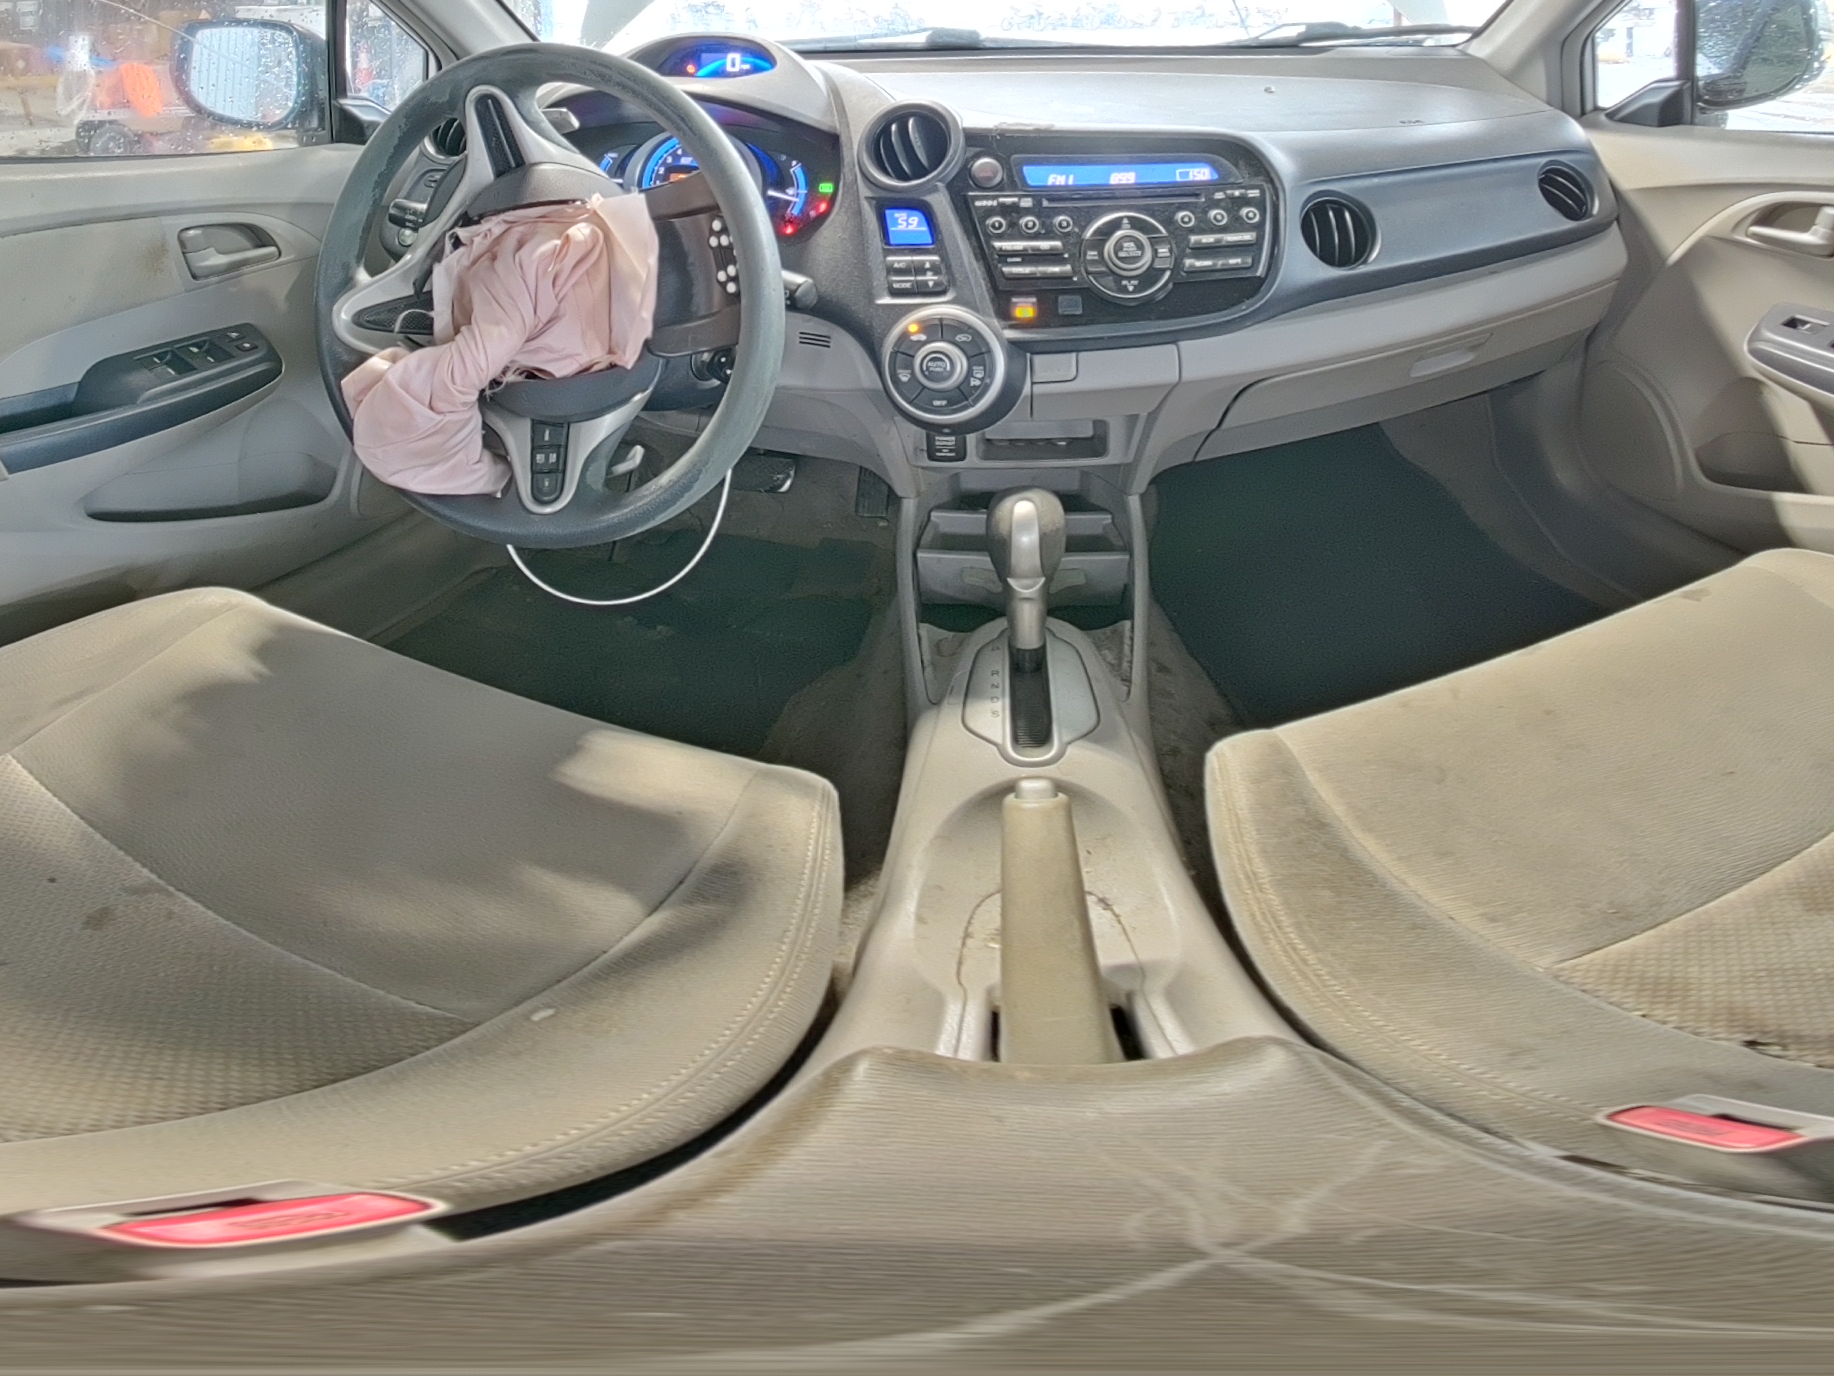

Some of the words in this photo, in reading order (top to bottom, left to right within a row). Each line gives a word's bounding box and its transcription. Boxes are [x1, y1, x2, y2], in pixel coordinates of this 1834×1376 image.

[726, 52, 741, 72] 0
[991, 669, 1001, 677] R
[991, 682, 1001, 690] N
[991, 696, 1001, 704] D
[991, 710, 1000, 718] S
